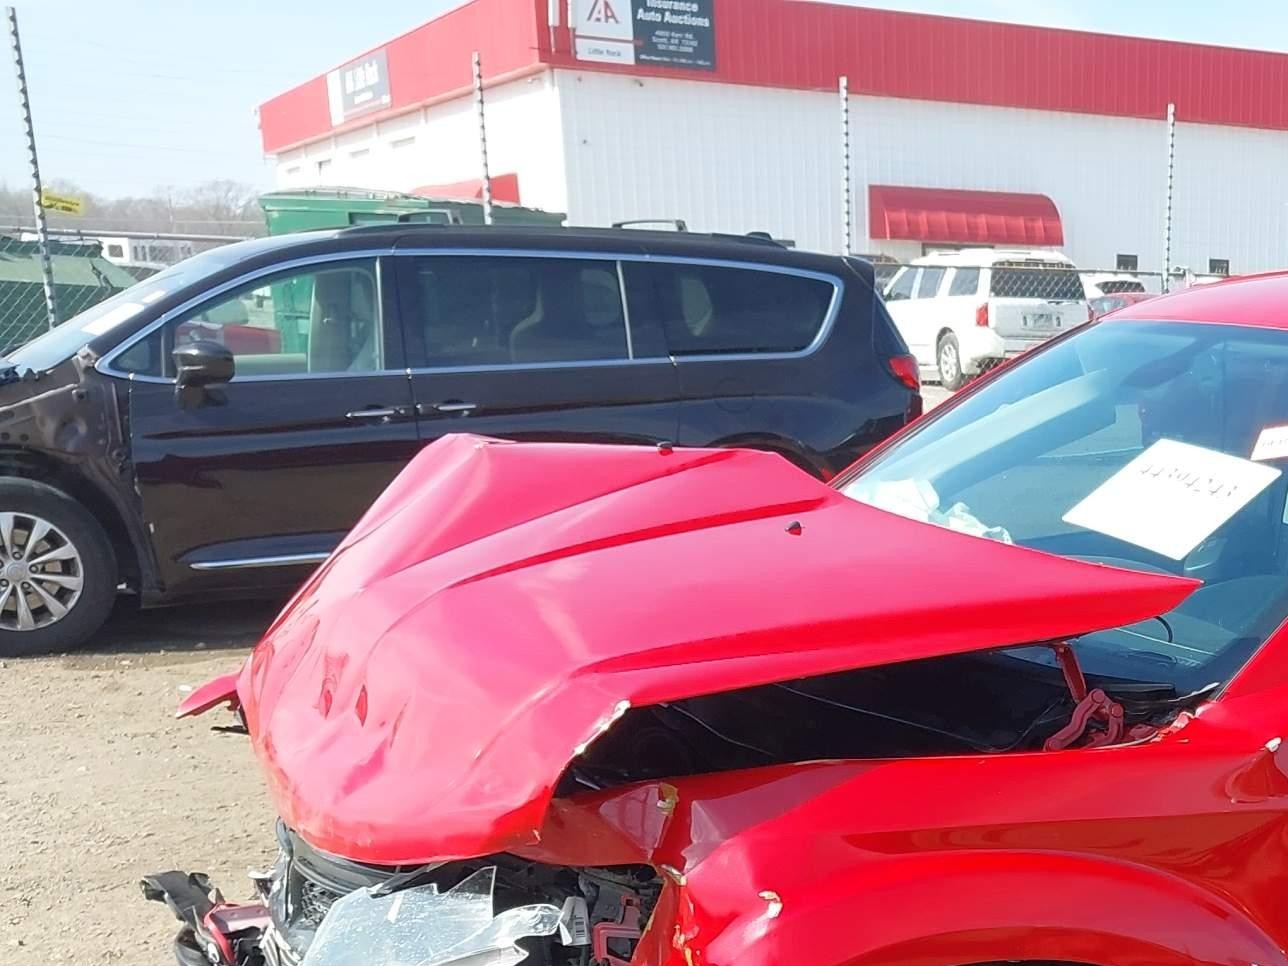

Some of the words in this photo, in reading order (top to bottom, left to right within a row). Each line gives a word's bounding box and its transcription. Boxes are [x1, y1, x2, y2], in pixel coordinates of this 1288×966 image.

[646, 0, 699, 12] Insurance
[636, 8, 662, 22] Auto
[663, 11, 710, 27] Auctions
